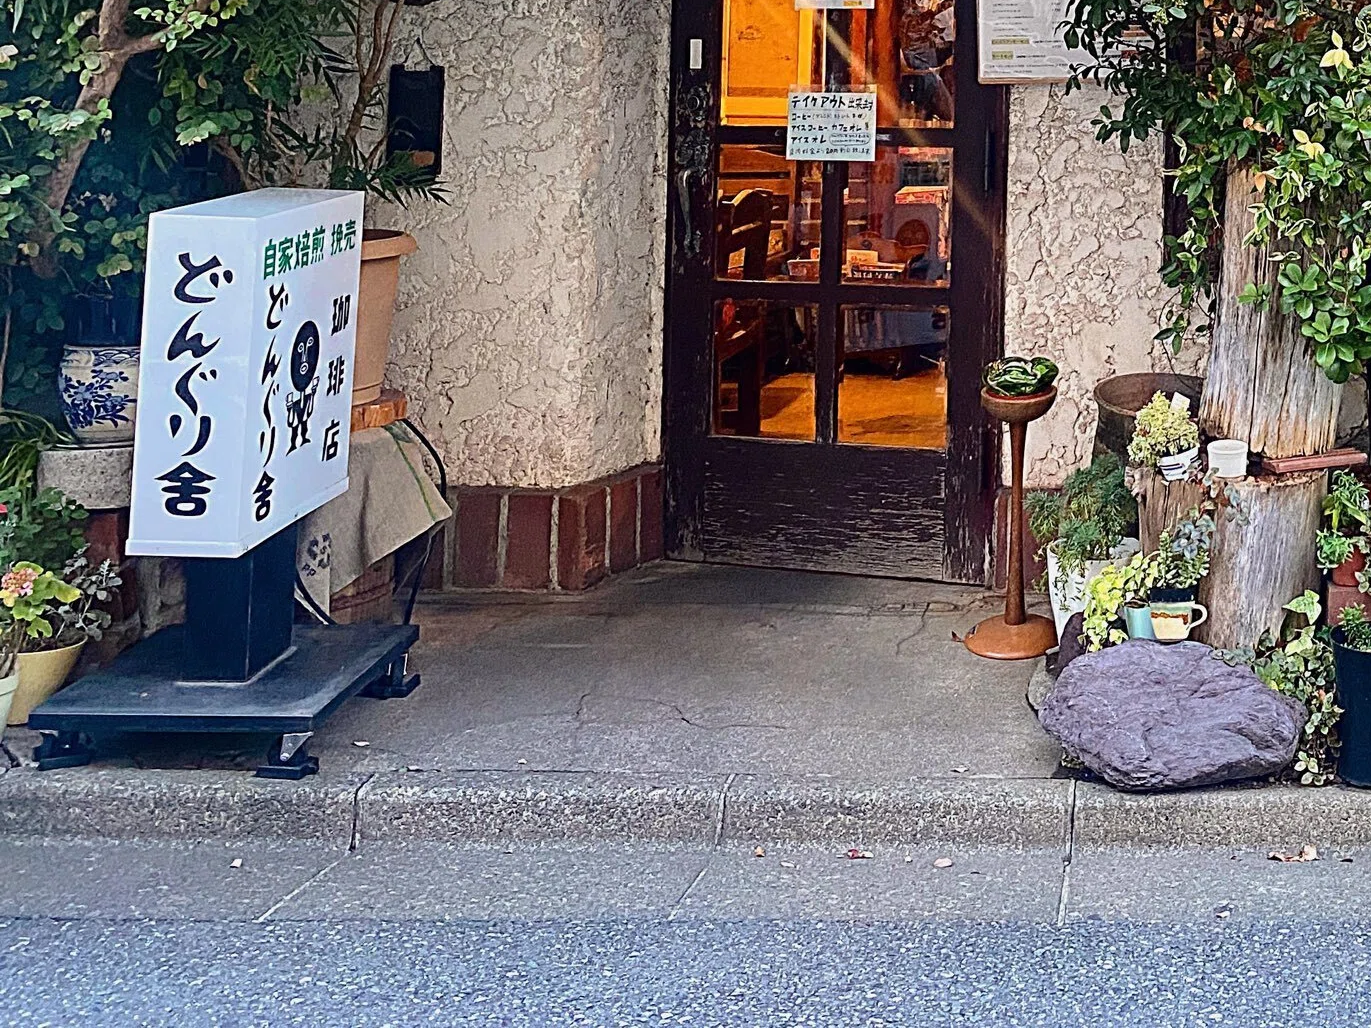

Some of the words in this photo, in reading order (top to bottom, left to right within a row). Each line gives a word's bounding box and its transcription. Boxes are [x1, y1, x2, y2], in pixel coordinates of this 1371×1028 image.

[791, 94, 846, 109] テイクアウト
[263, 224, 326, 280] 自家焙煎
[330, 219, 356, 256] 挽売
[154, 251, 234, 518] どんぐり舎
[252, 282, 290, 523] どんぐり舎
[320, 292, 352, 463] 珈琲店
